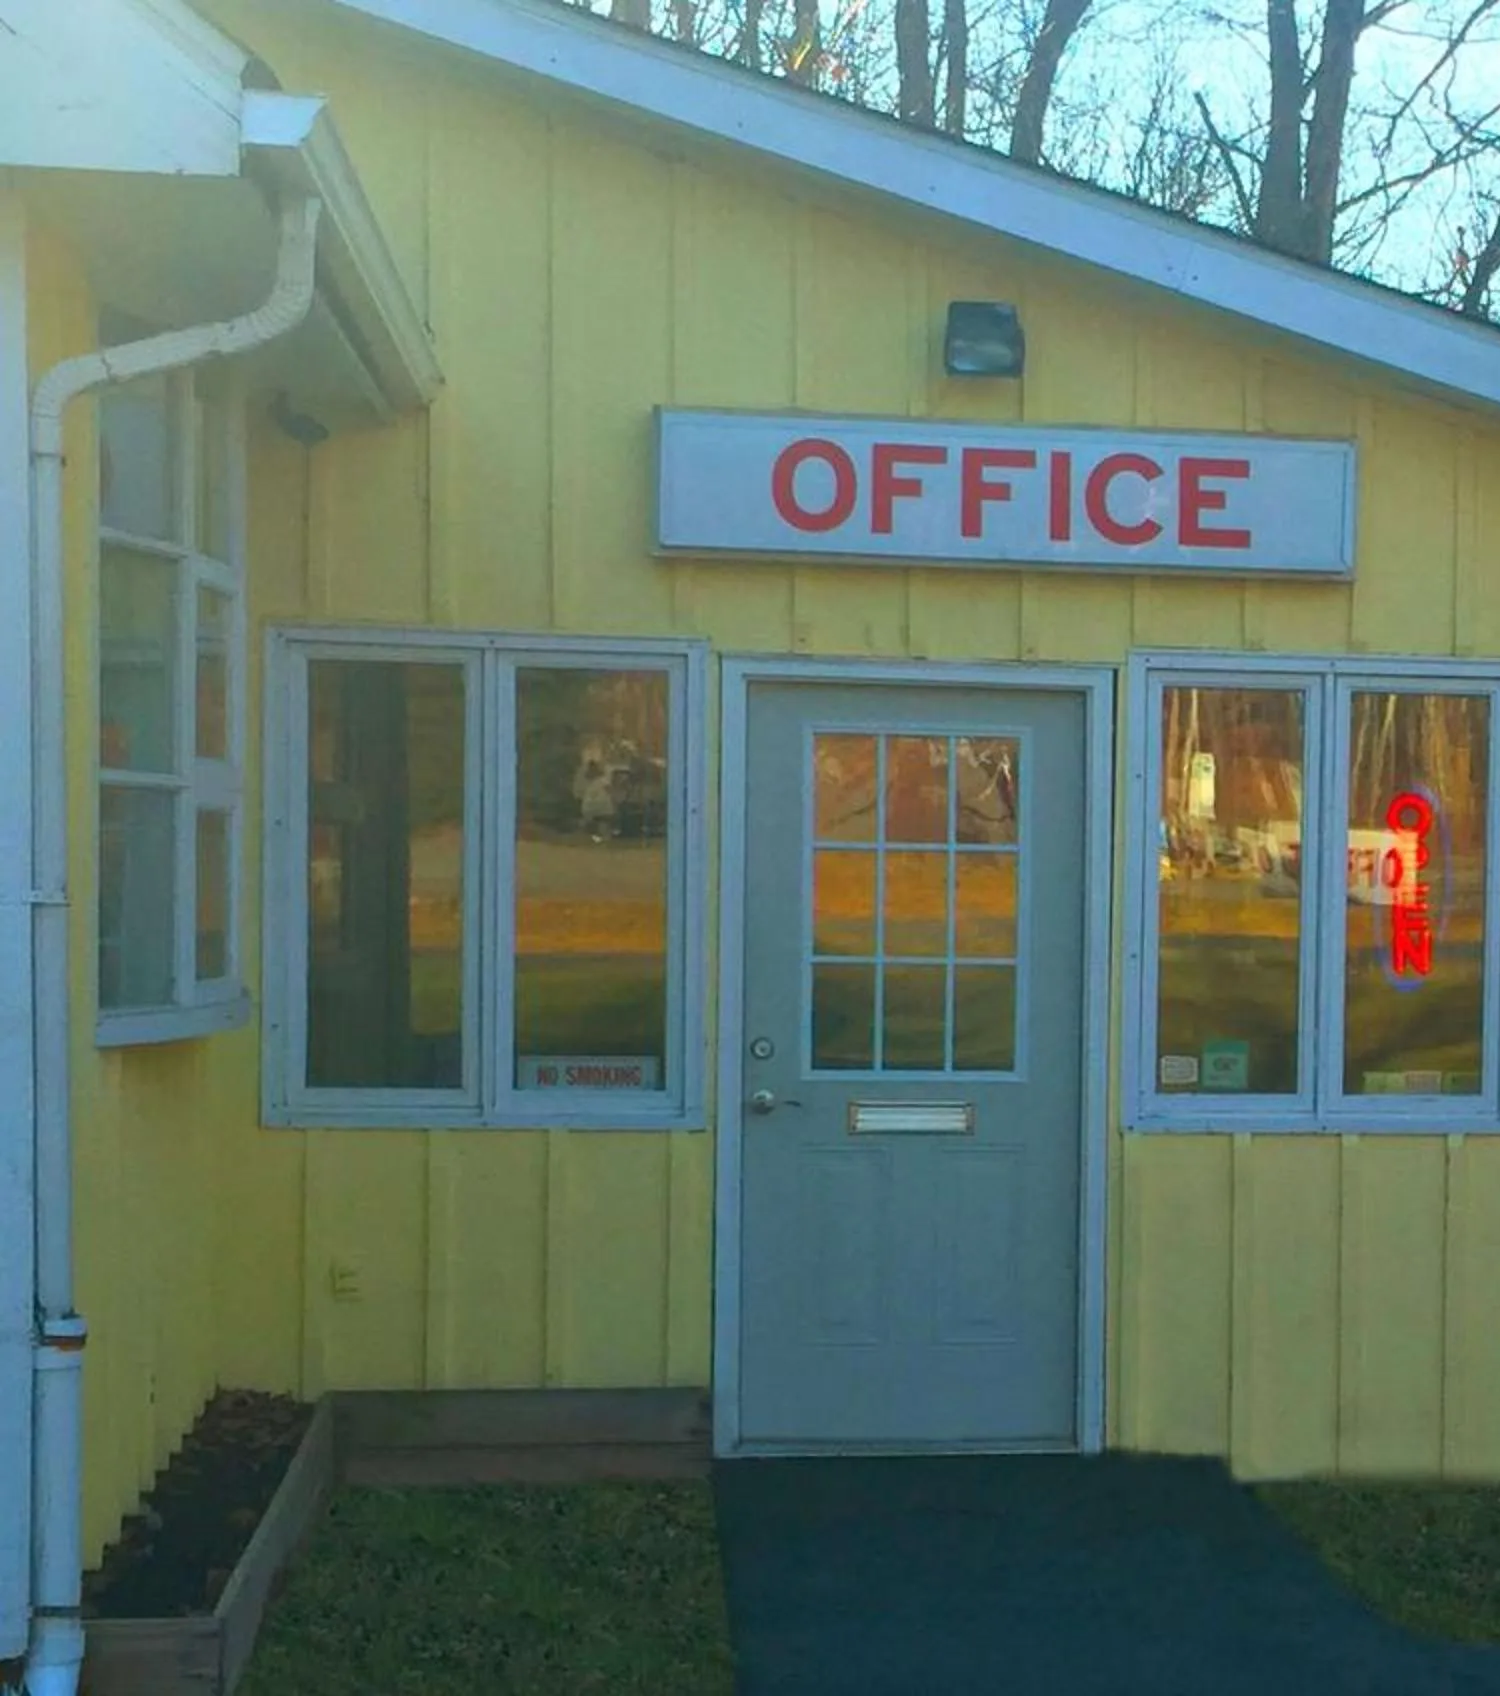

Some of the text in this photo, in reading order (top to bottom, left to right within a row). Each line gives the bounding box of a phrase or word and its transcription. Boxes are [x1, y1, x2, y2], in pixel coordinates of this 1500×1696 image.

[772, 438, 1252, 549] OFFICE
[1386, 792, 1432, 975] OPEN
[537, 1065, 642, 1087] NO SMOKING
